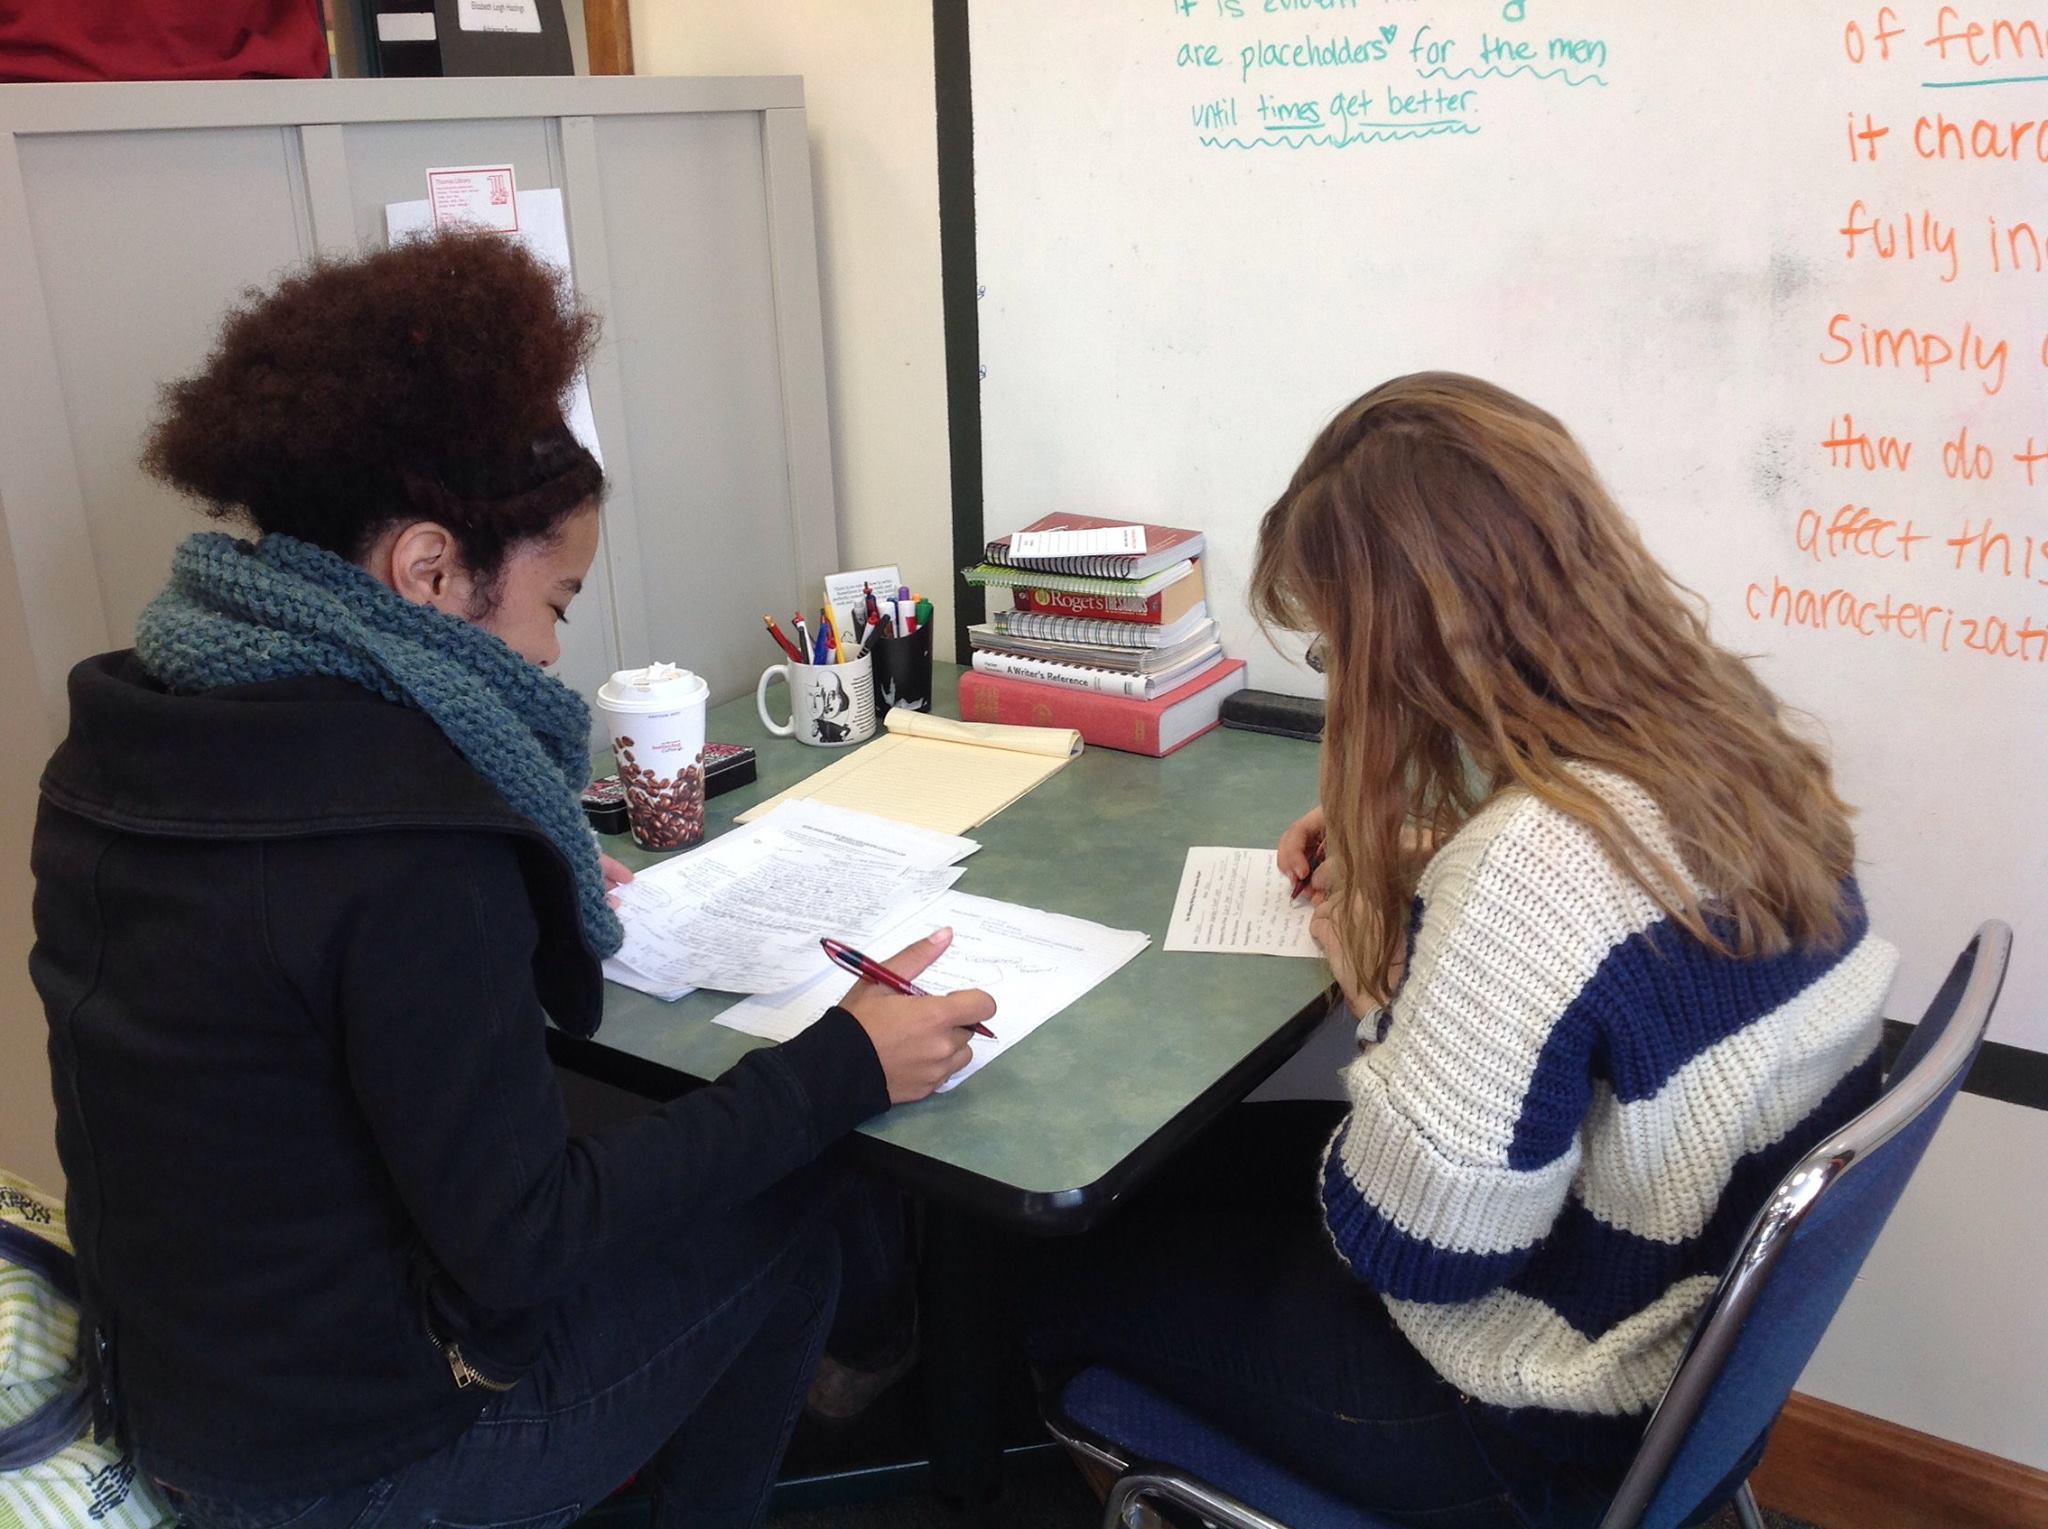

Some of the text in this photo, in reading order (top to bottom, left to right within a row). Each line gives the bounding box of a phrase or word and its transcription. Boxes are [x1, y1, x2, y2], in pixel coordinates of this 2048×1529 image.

[1177, 25, 1608, 83] are placeholders for the men
[1844, 5, 2048, 66] of fem
[1192, 97, 1236, 129] until
[1257, 94, 1320, 124] times
[1330, 89, 1374, 147] get
[1847, 112, 1890, 162] it
[1840, 200, 2048, 283] fully in
[1820, 413, 1913, 472] How
[1942, 427, 1995, 481] do
[1796, 503, 1932, 562] affect
[1051, 590, 1104, 613] Roget's
[1006, 665, 1014, 675] A
[1013, 667, 1045, 680] Writer's
[1047, 671, 1089, 688] Reference
